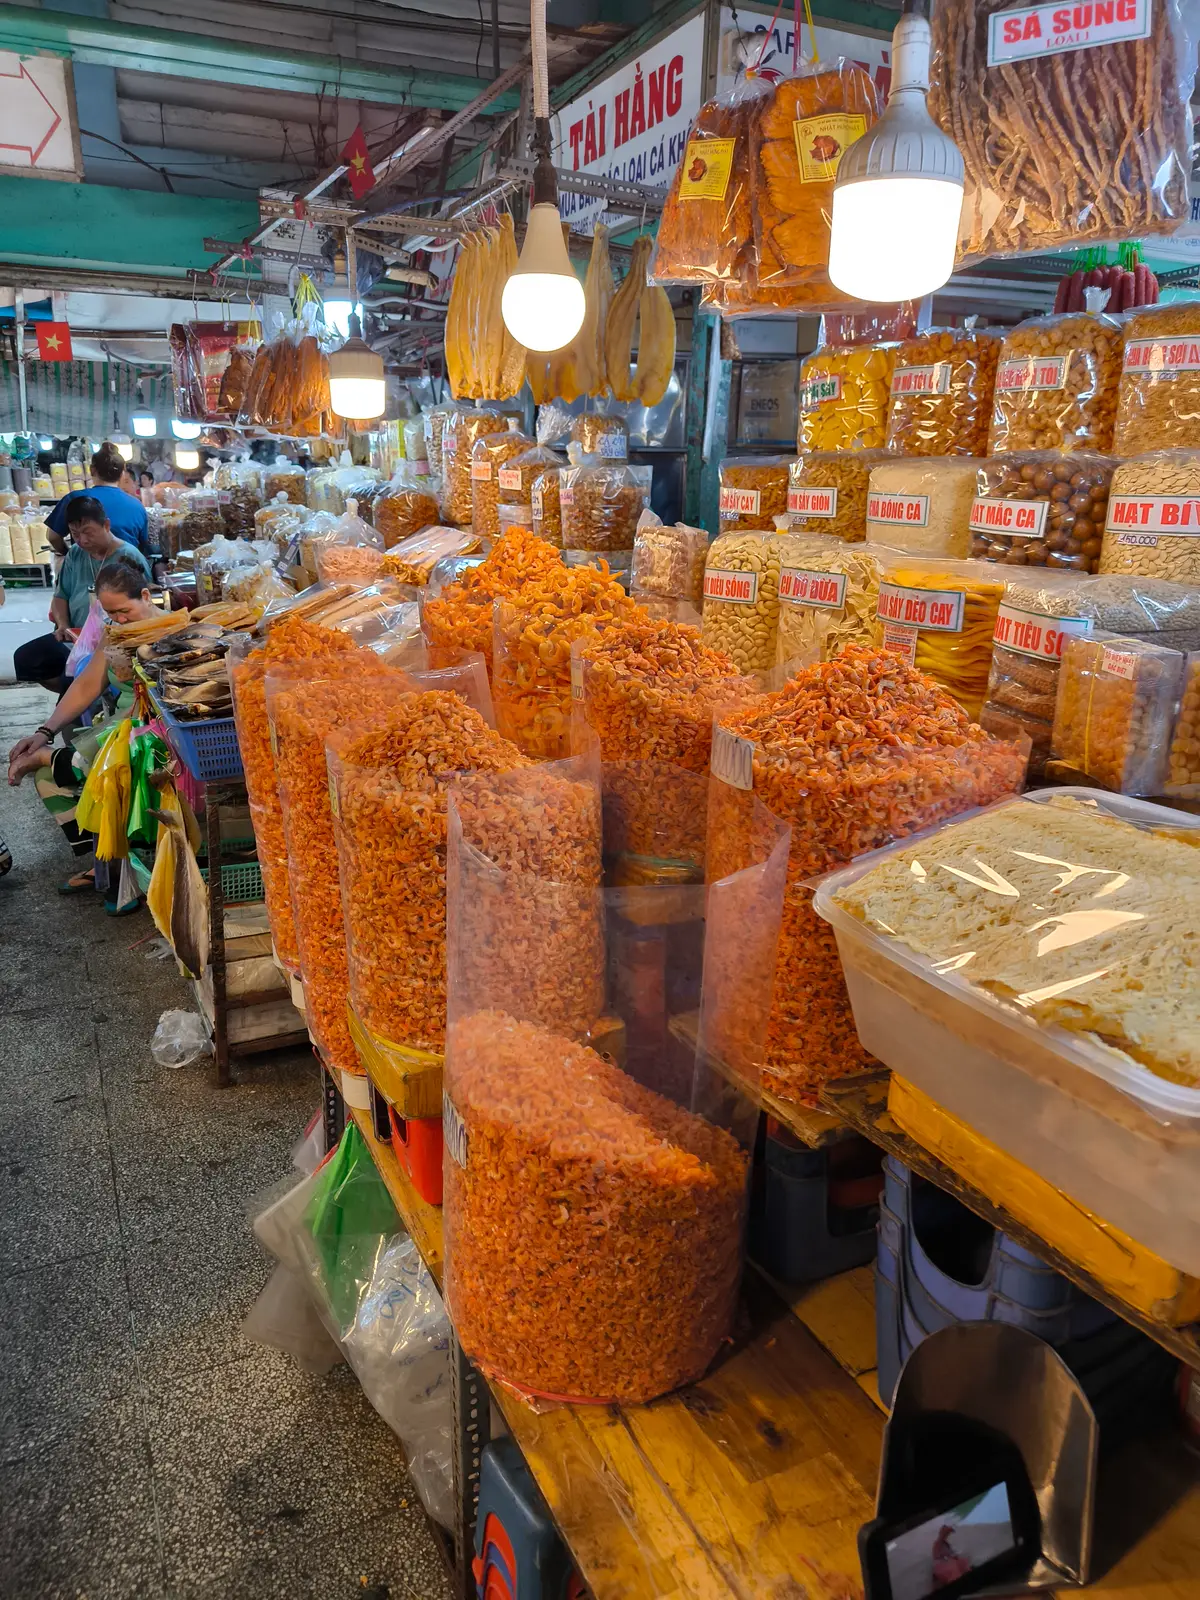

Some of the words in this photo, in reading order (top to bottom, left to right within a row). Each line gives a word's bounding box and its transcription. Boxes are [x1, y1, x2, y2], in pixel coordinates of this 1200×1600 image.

[1003, 11, 1042, 44] SÁ
[569, 100, 607, 172] TÀI
[614, 54, 684, 150] HẰNG
[649, 134, 665, 177] CÁ
[741, 495, 755, 511] CAY
[811, 493, 830, 511] GIÒN
[906, 500, 921, 520] CÁ
[986, 501, 1012, 527] MẮC
[1015, 508, 1036, 528] CA
[1113, 503, 1154, 527] HẠT
[725, 575, 750, 599] SỐNG
[889, 590, 904, 619] SẤY
[905, 595, 927, 623] DẺO
[930, 602, 954, 625] CAY
[1013, 620, 1042, 651] TIÊU
